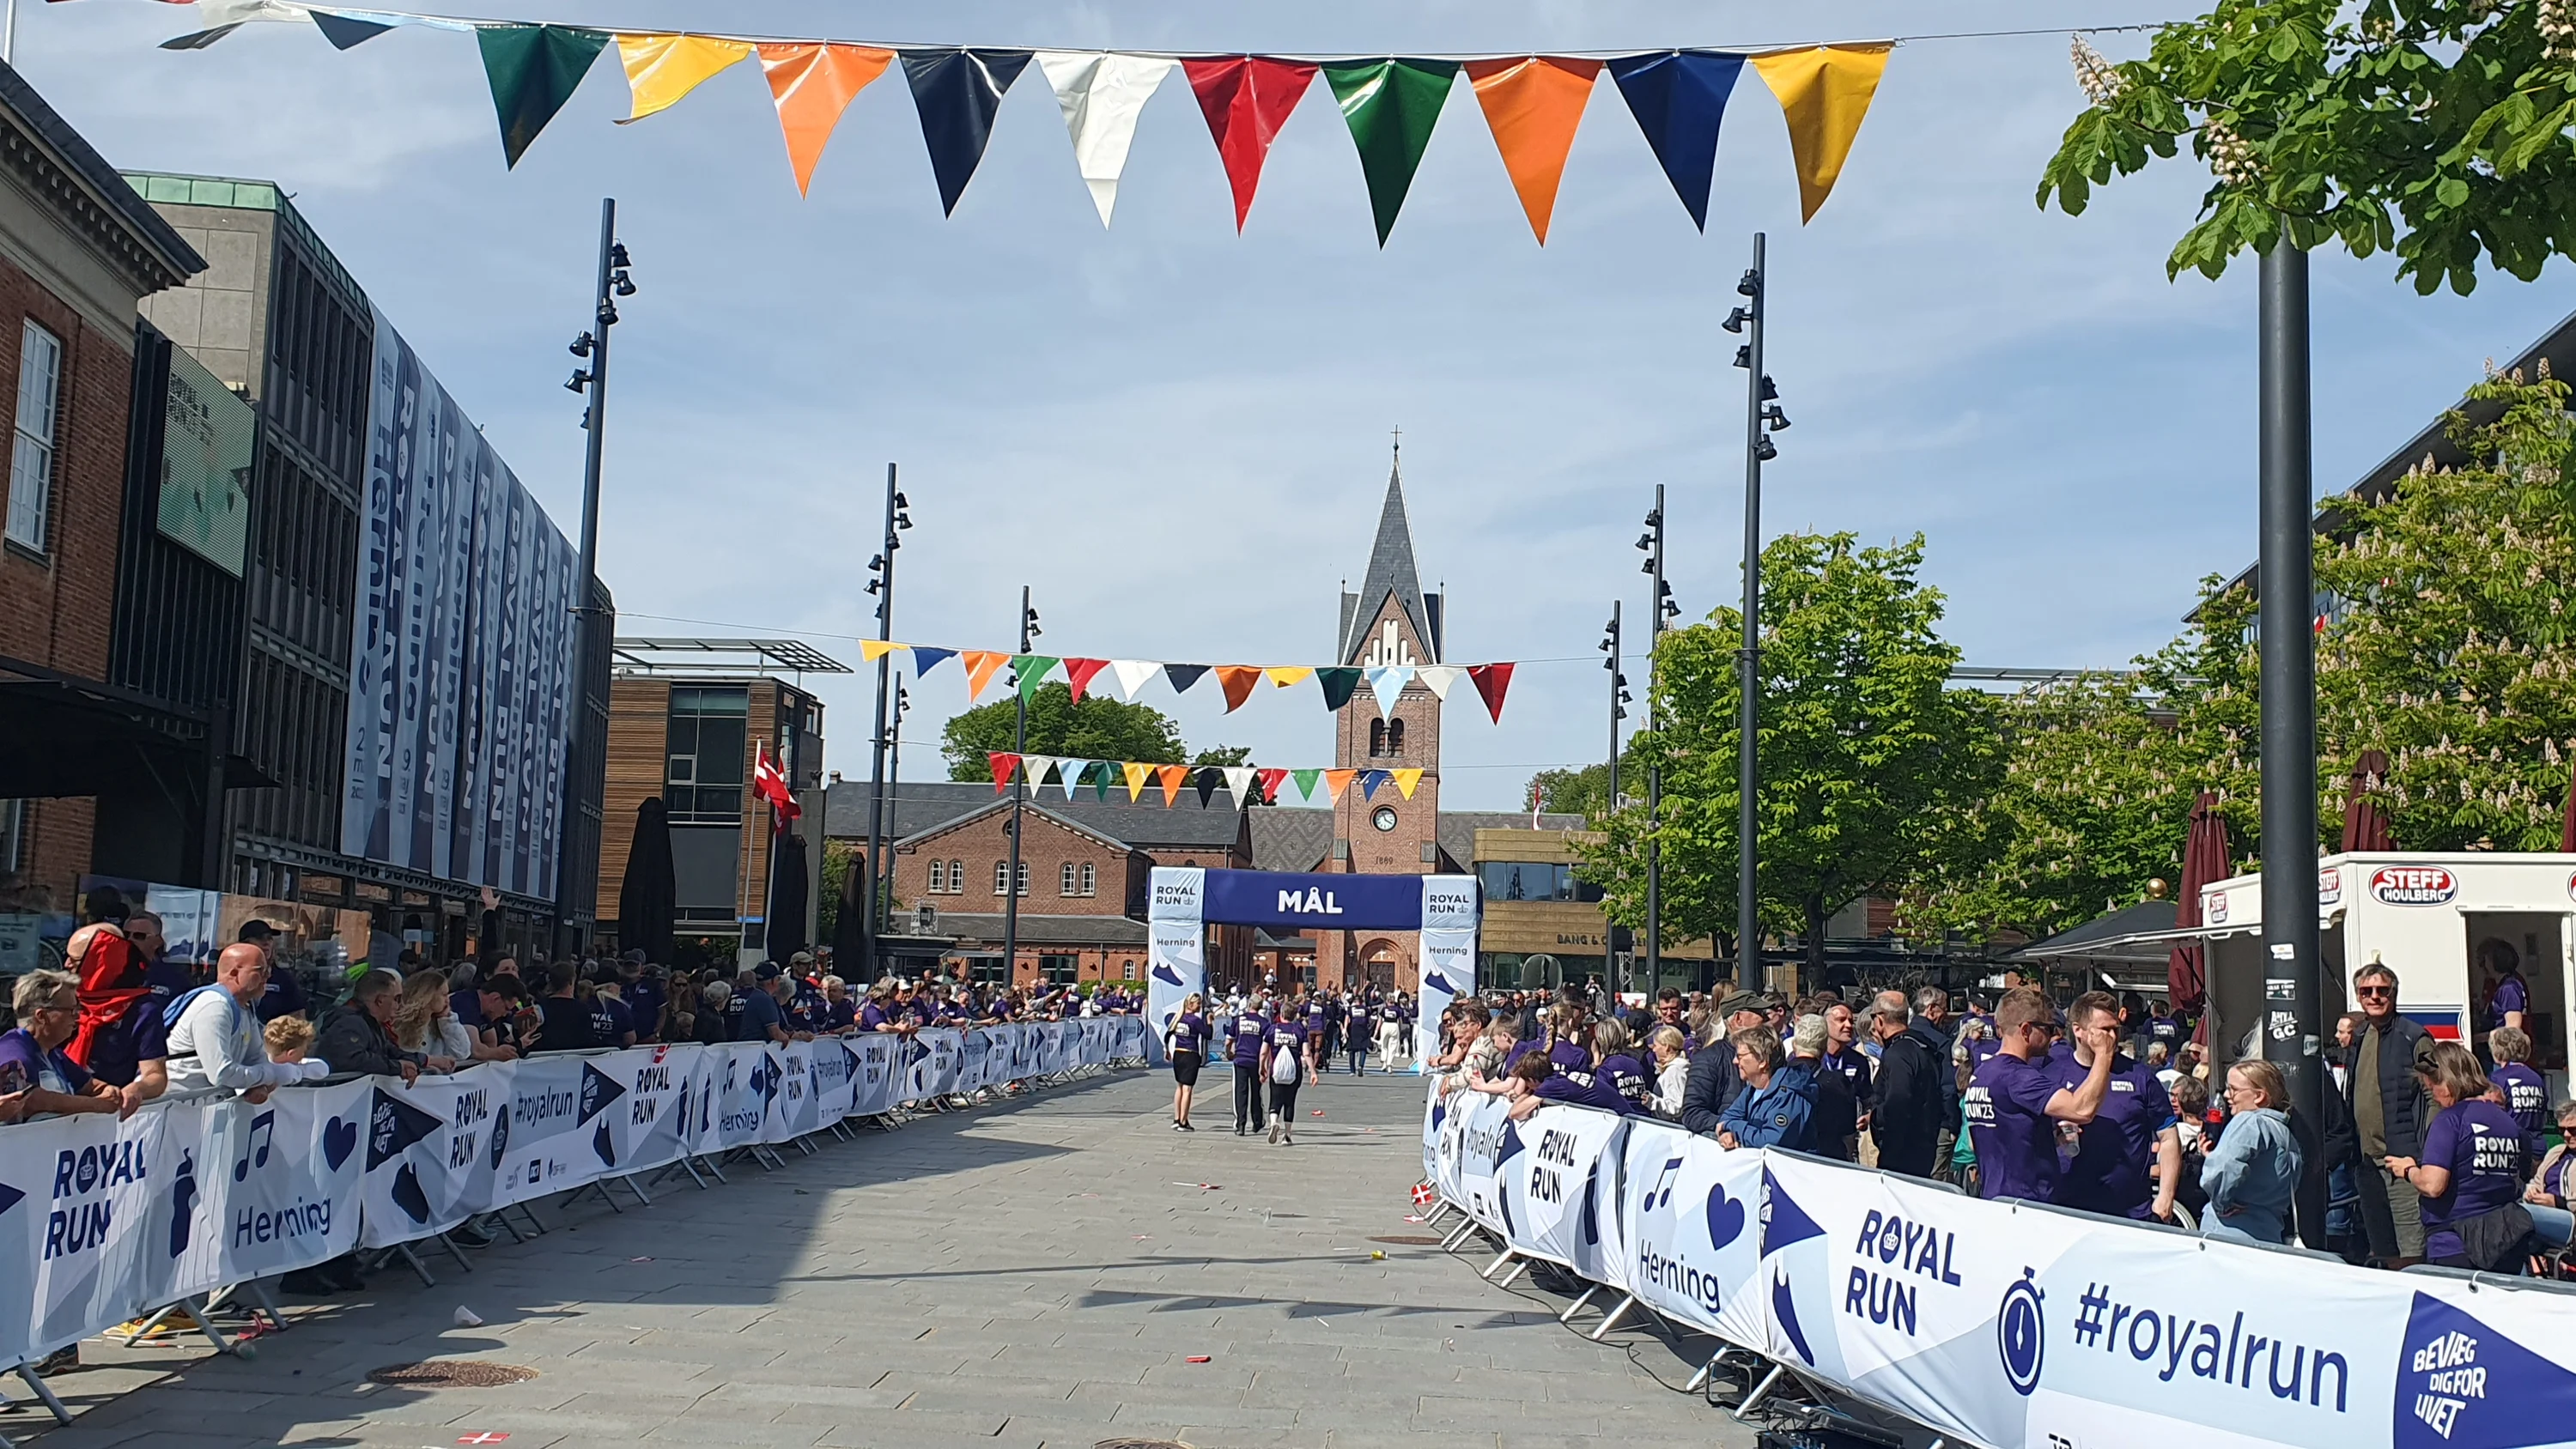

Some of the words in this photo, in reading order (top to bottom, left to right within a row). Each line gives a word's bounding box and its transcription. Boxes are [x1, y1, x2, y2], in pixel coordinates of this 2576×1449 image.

[1157, 885, 1196, 895] ROYAL
[2383, 870, 2444, 888] STEFF
[1157, 895, 1182, 905] RUN
[1278, 887, 1343, 914] MÅL
[1429, 894, 1469, 904] ROYAL
[1429, 903, 1455, 913] RUN
[2384, 889, 2446, 901] HOULBERG
[1157, 937, 1195, 949] Herning
[1429, 945, 1467, 956] Herning
[1557, 933, 1588, 945] BANG
[635, 1065, 670, 1094] ROYAL
[787, 1079, 803, 1100] RUN
[866, 1067, 880, 1084] RUN
[2511, 1086, 2544, 1098] ROYAL
[455, 1088, 488, 1129] ROYAL
[632, 1098, 657, 1126] RUN
[449, 1131, 477, 1170] RUN
[1538, 1129, 1577, 1167] ROYAL
[2475, 1137, 2521, 1153] ROYAL
[53, 1137, 146, 1201] ROYAL
[1530, 1167, 1563, 1204] RUN
[45, 1200, 112, 1261] RUN
[235, 1195, 332, 1249] Herning
[1856, 1209, 1962, 1288] ROYAL
[1640, 1240, 1722, 1314] Herning
[1844, 1266, 1917, 1337] RUN
[2073, 1282, 2349, 1413] #royalrun
[2413, 1331, 2477, 1373] BEVÆG
[2415, 1393, 2467, 1440] LIVET
